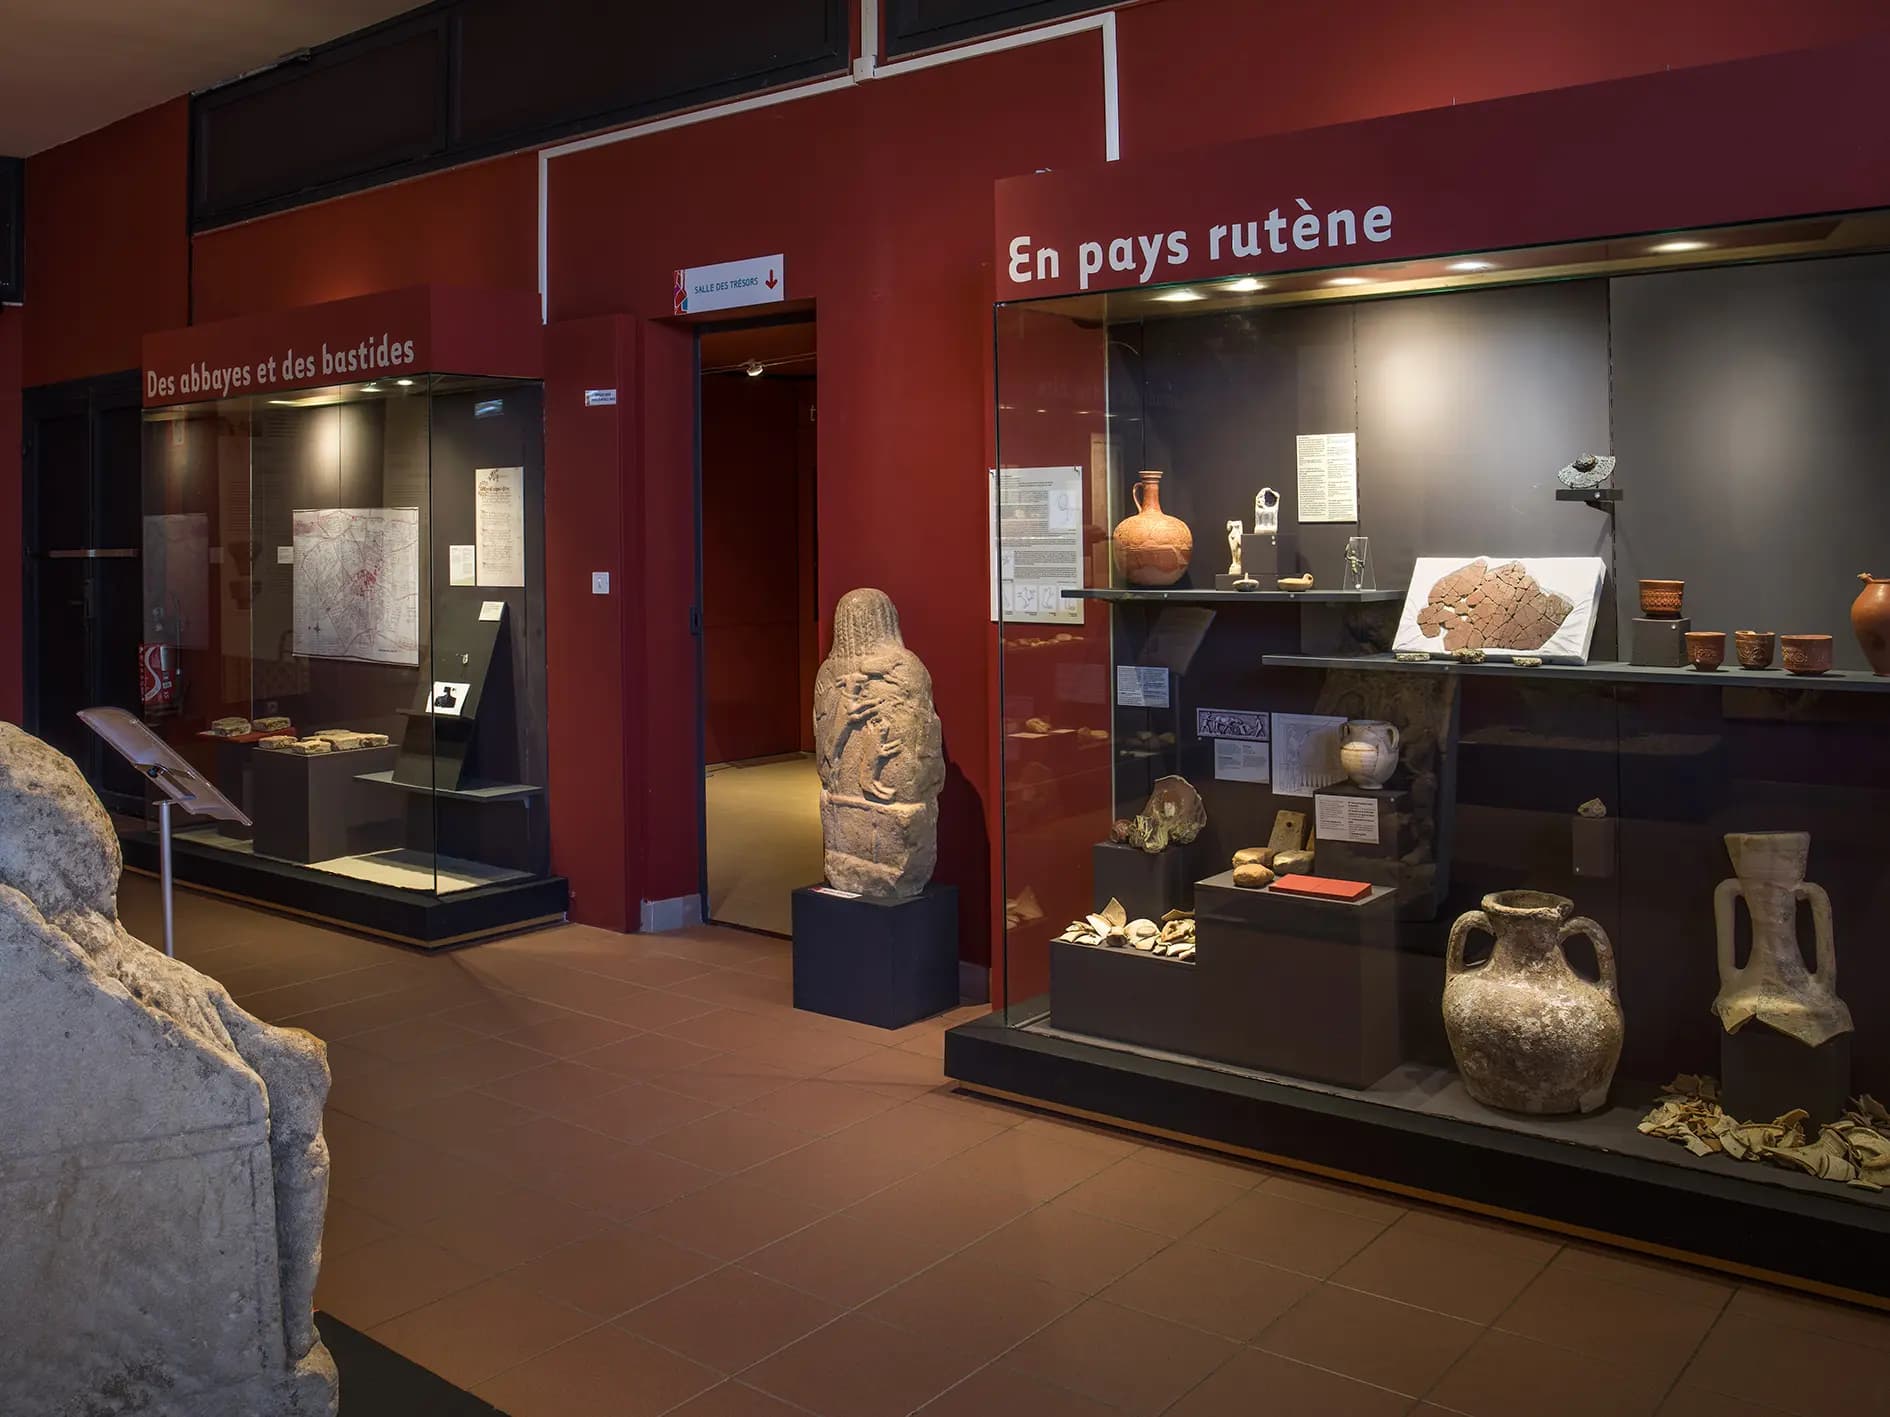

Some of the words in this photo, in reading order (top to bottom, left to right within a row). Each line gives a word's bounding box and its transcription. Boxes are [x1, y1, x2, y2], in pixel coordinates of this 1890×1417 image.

[1009, 236, 1060, 283] En
[1079, 230, 1189, 290] pays
[1209, 198, 1393, 261] rutène
[694, 284, 715, 294] SALLE
[716, 281, 729, 291] DES
[730, 277, 759, 289] TRÉSORS
[147, 370, 175, 398] Des
[180, 362, 251, 397] abbayes
[257, 356, 276, 384] et
[282, 349, 316, 381] des
[322, 333, 414, 375] bastides
